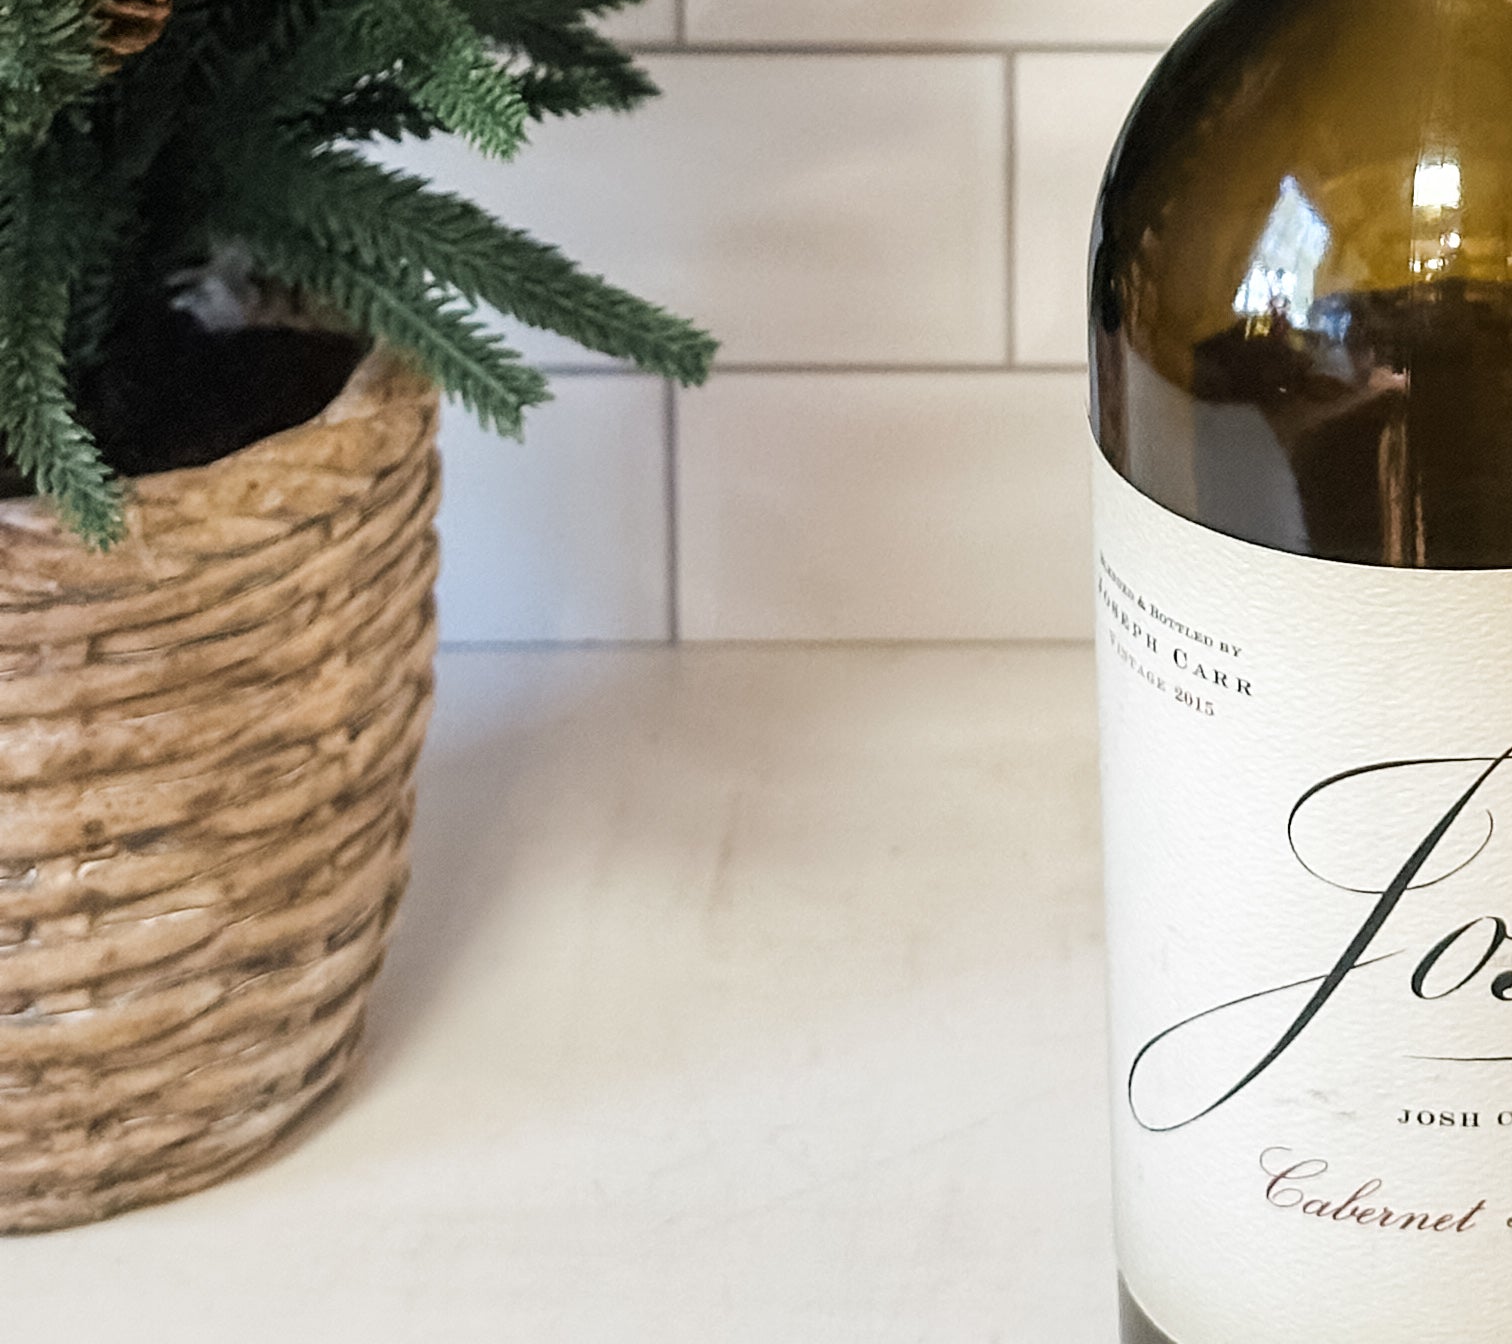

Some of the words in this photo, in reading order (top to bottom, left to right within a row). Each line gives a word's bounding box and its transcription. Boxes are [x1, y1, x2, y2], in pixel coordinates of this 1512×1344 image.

[1098, 577, 1158, 654] JOSEPH
[1173, 647, 1252, 697] CARR
[1109, 629, 1167, 692] VINTAGE
[1174, 686, 1215, 717] 2015
[1150, 603, 1214, 648] BOTTLED
[1219, 640, 1243, 658] BY
[1397, 1108, 1482, 1129] JOSH
[1259, 1146, 1487, 1234] Cabernet
